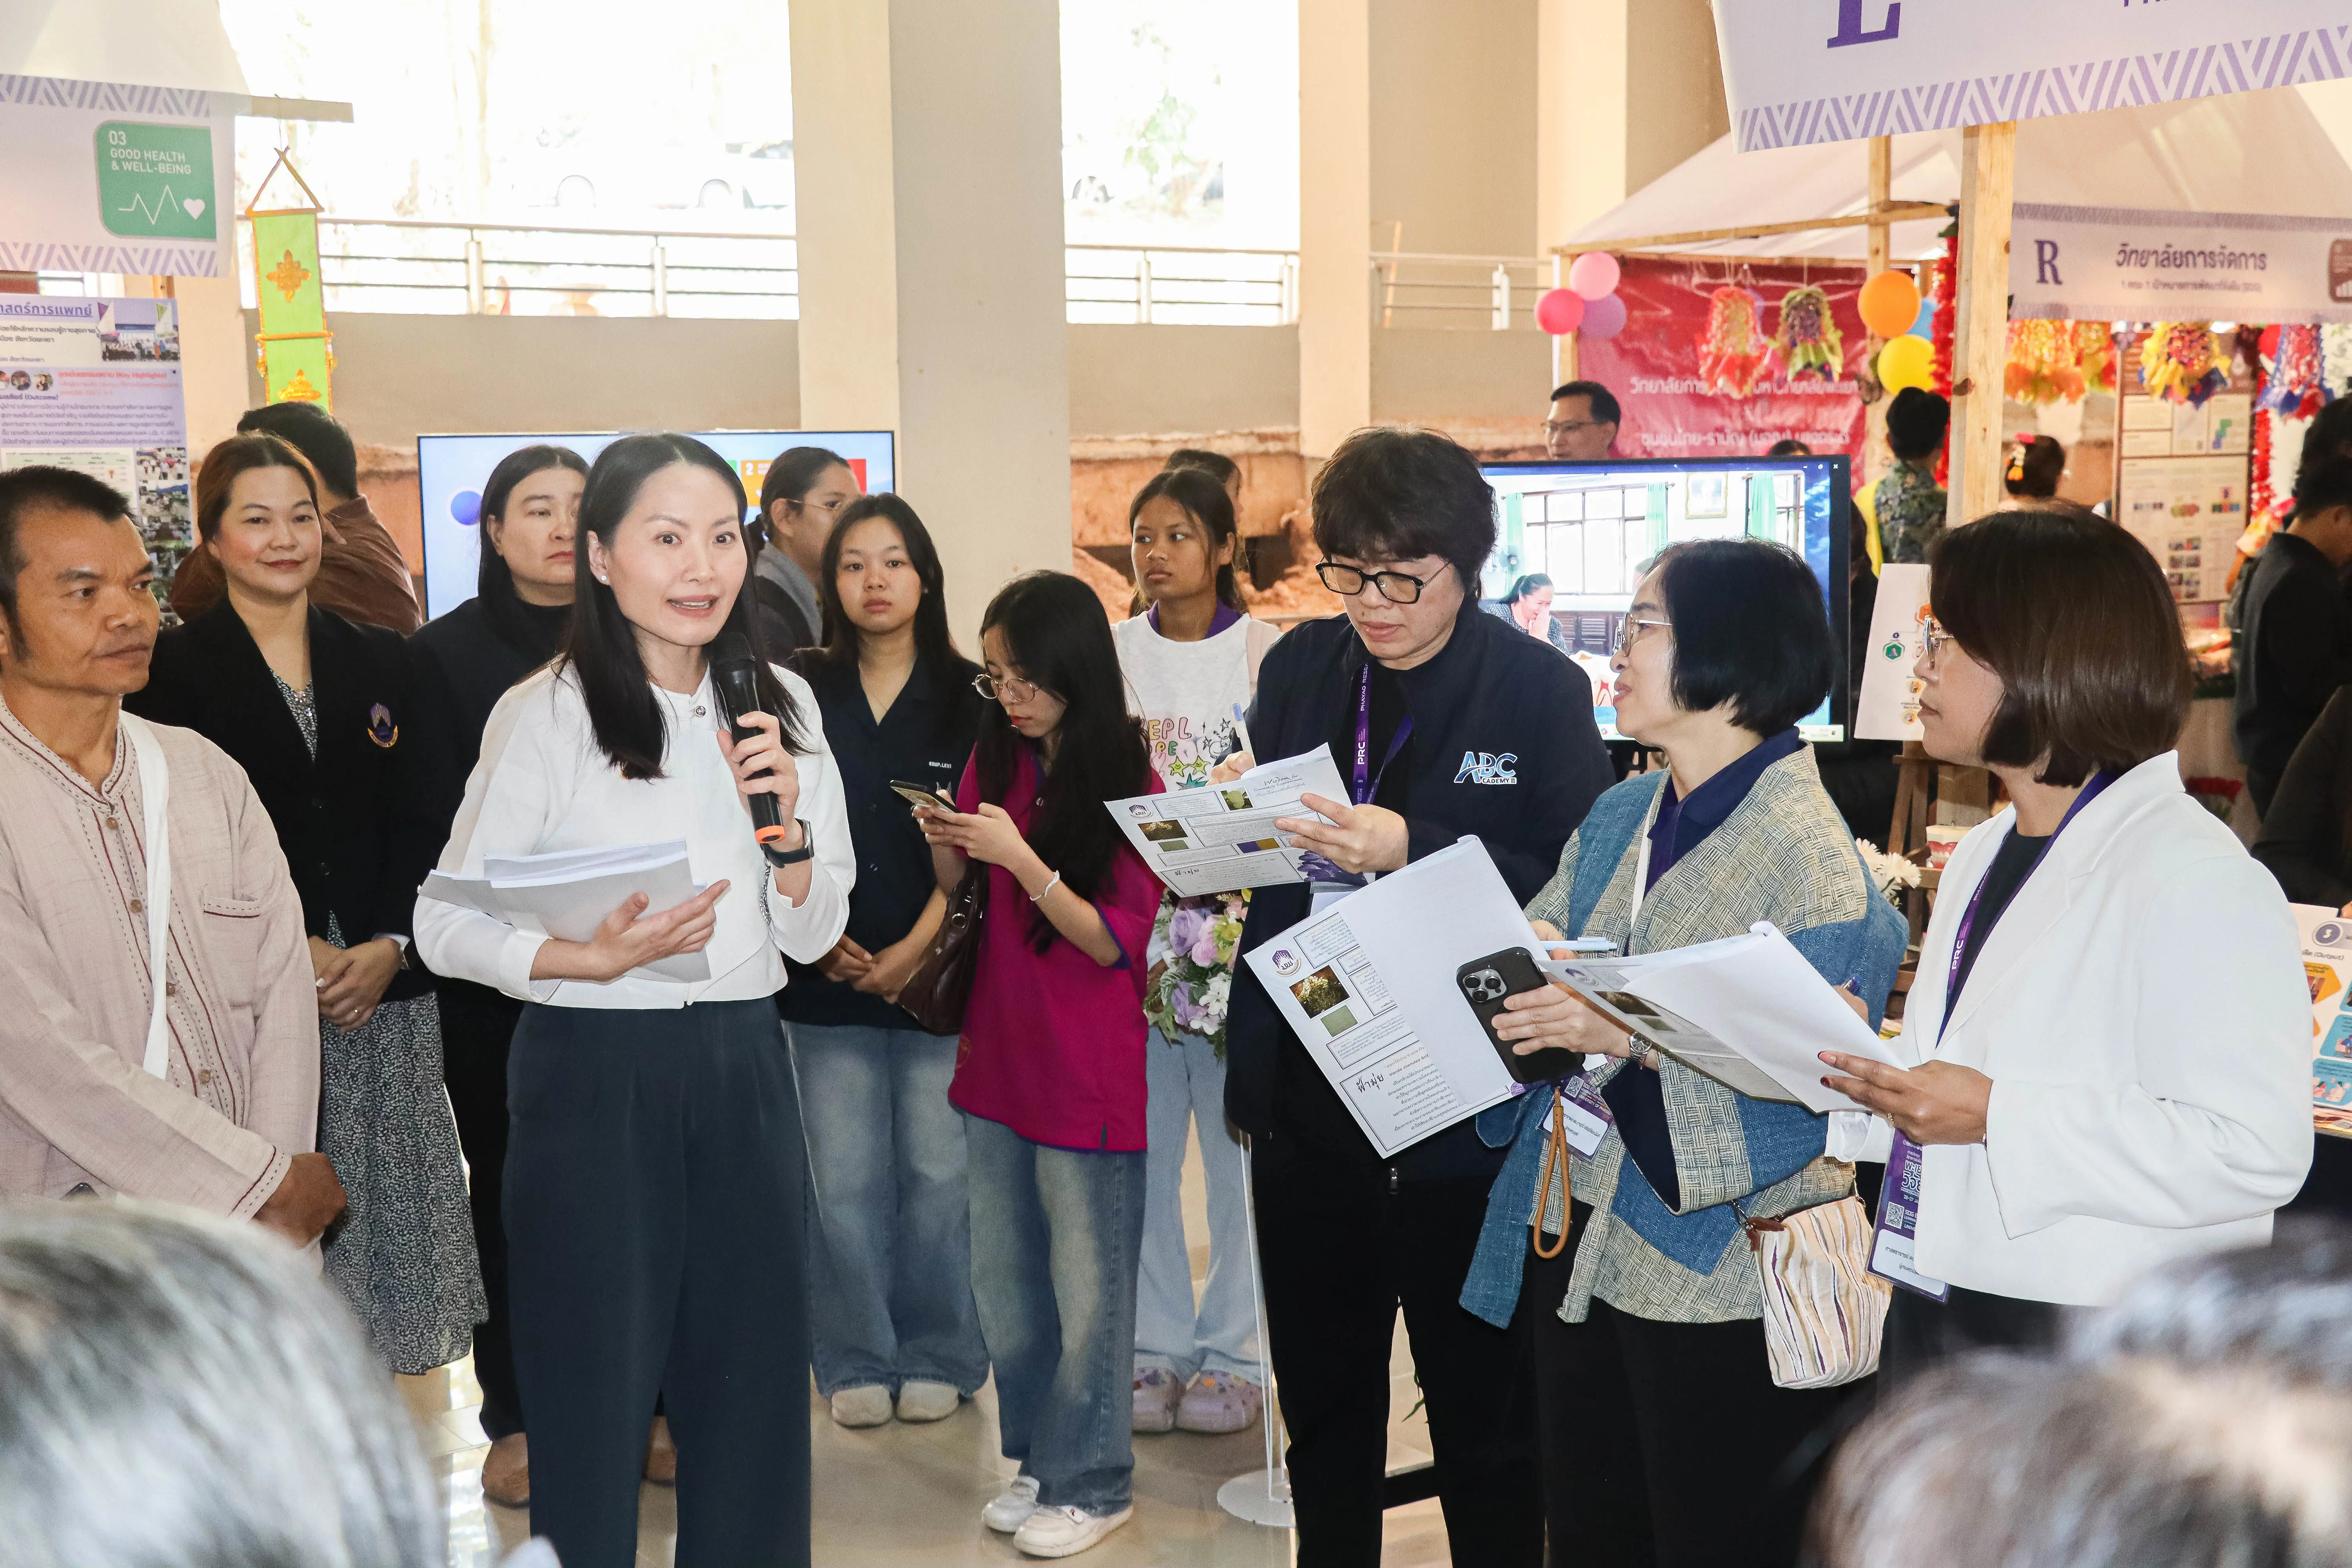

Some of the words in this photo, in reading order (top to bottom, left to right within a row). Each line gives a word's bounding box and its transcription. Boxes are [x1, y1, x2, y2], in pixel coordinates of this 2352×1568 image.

[109, 131, 127, 145] 03
[111, 149, 140, 160] GOOD
[143, 150, 185, 162] HEALTH
[111, 161, 120, 171] &
[123, 162, 191, 174] WELL-BEING
[2035, 239, 2062, 285] R
[2116, 242, 2267, 271] วิทยาลัยการจัดการ
[746, 463, 754, 475] 2
[1357, 742, 1365, 765] PRC
[1454, 751, 1518, 783] ABC
[1264, 777, 1290, 785] Wisdom
[1952, 940, 1964, 970] PRC
[1389, 1067, 1403, 1077] Vanda
[1356, 1073, 1385, 1093] ฟ้ามุ่ย
[1905, 1160, 1921, 1175] พะเย
